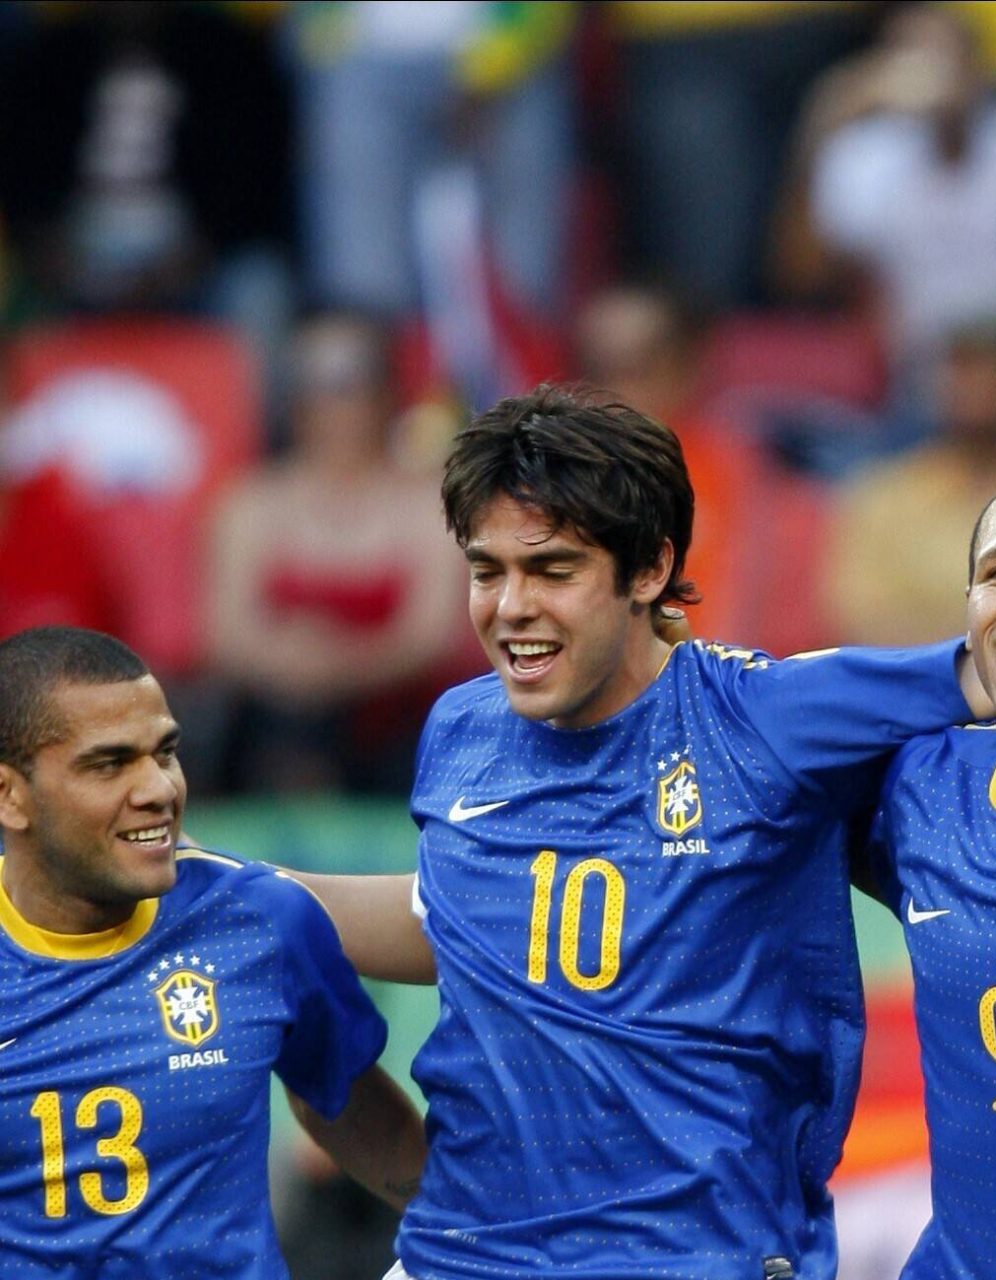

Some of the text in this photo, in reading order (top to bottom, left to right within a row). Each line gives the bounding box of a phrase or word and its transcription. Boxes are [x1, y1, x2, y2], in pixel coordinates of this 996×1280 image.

[662, 839, 710, 857] BRASIL
[528, 850, 625, 990] 10
[178, 1001, 199, 1010] CBF
[168, 1049, 229, 1070] BRASIL
[30, 1086, 149, 1218] 13
